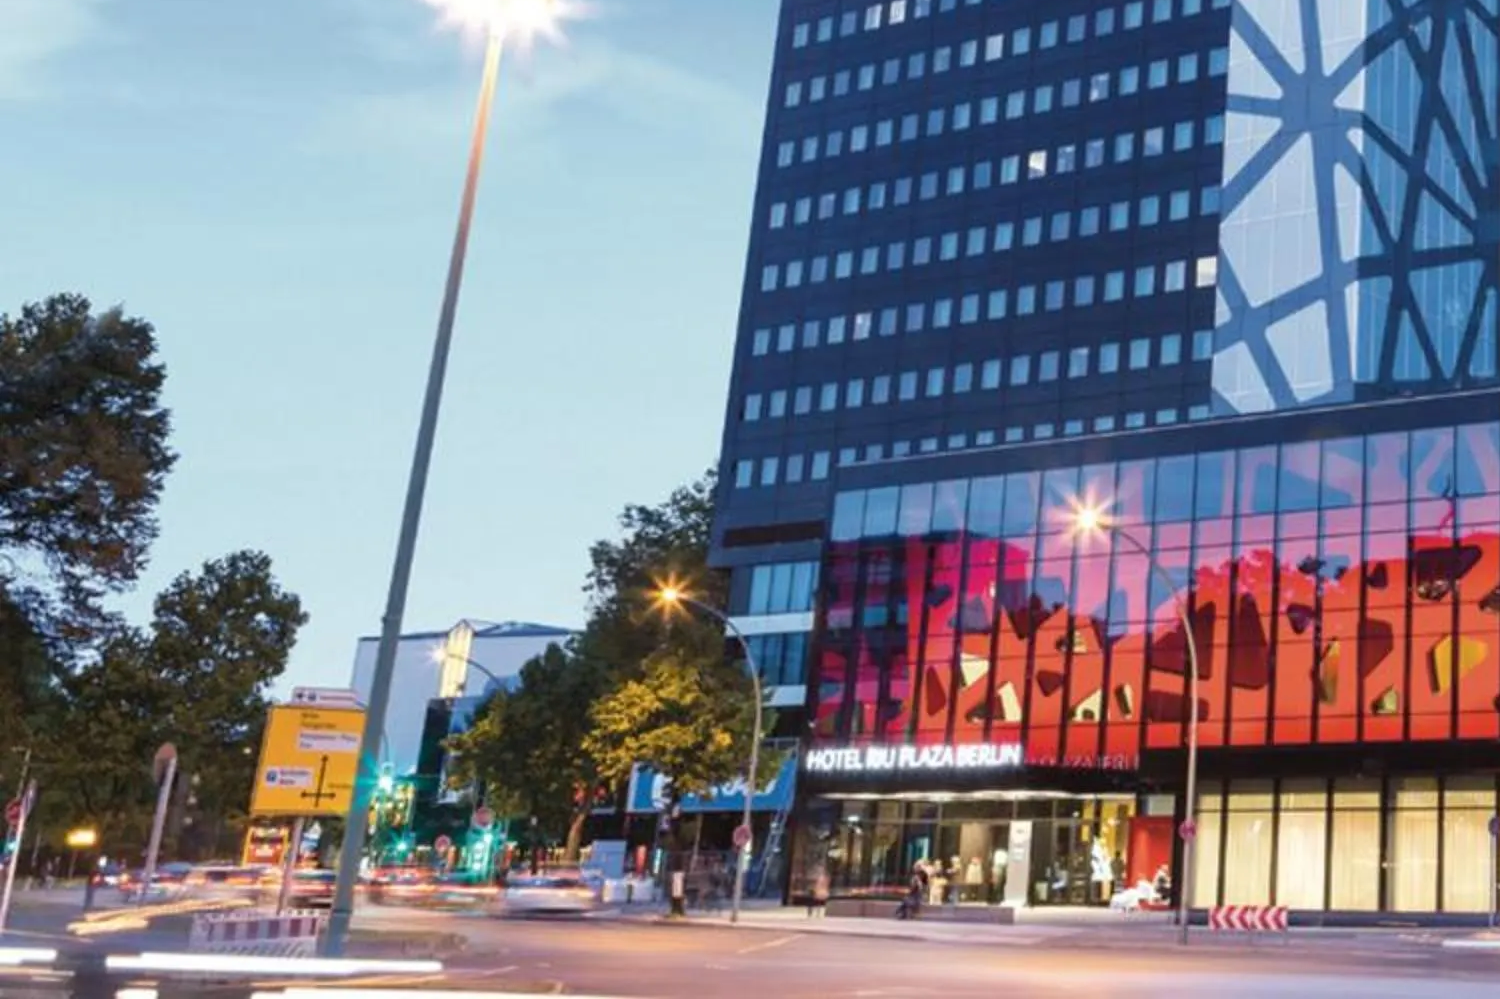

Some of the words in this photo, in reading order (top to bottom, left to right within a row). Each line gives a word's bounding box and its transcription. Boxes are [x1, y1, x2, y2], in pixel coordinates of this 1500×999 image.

[806, 749, 863, 770] HOTEL
[865, 746, 897, 769] RIU
[898, 744, 954, 768] PLAZA
[955, 743, 1022, 767] BERLIN
